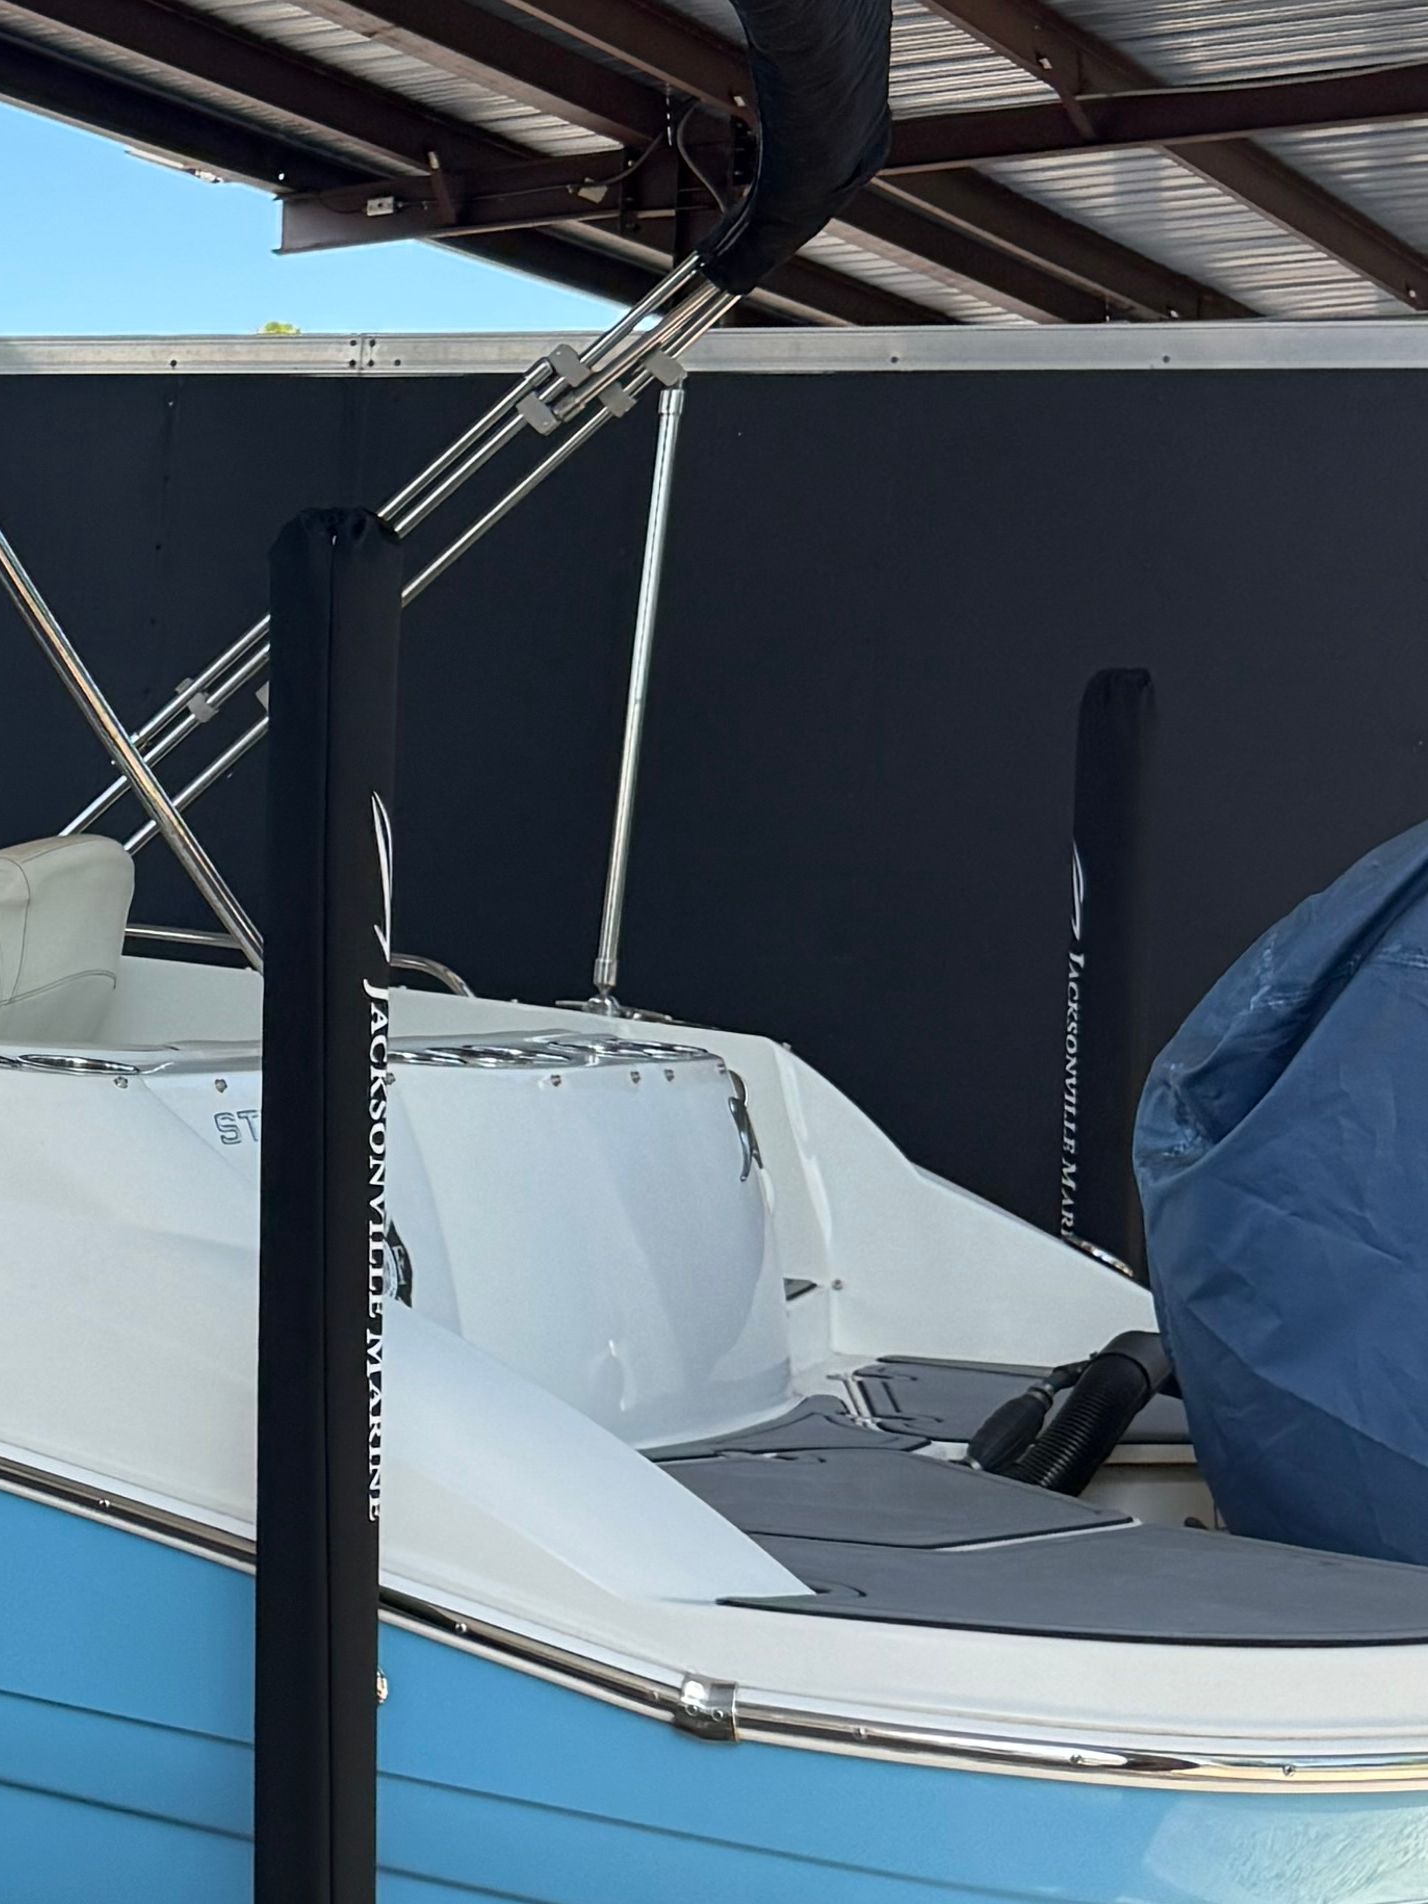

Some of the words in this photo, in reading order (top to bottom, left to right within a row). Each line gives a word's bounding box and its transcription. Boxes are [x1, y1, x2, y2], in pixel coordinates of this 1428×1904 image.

[363, 977, 389, 1320] JACKSONVILLE
[1061, 951, 1085, 1155] JACKSONVILLE
[365, 1327, 384, 1522] MARINE
